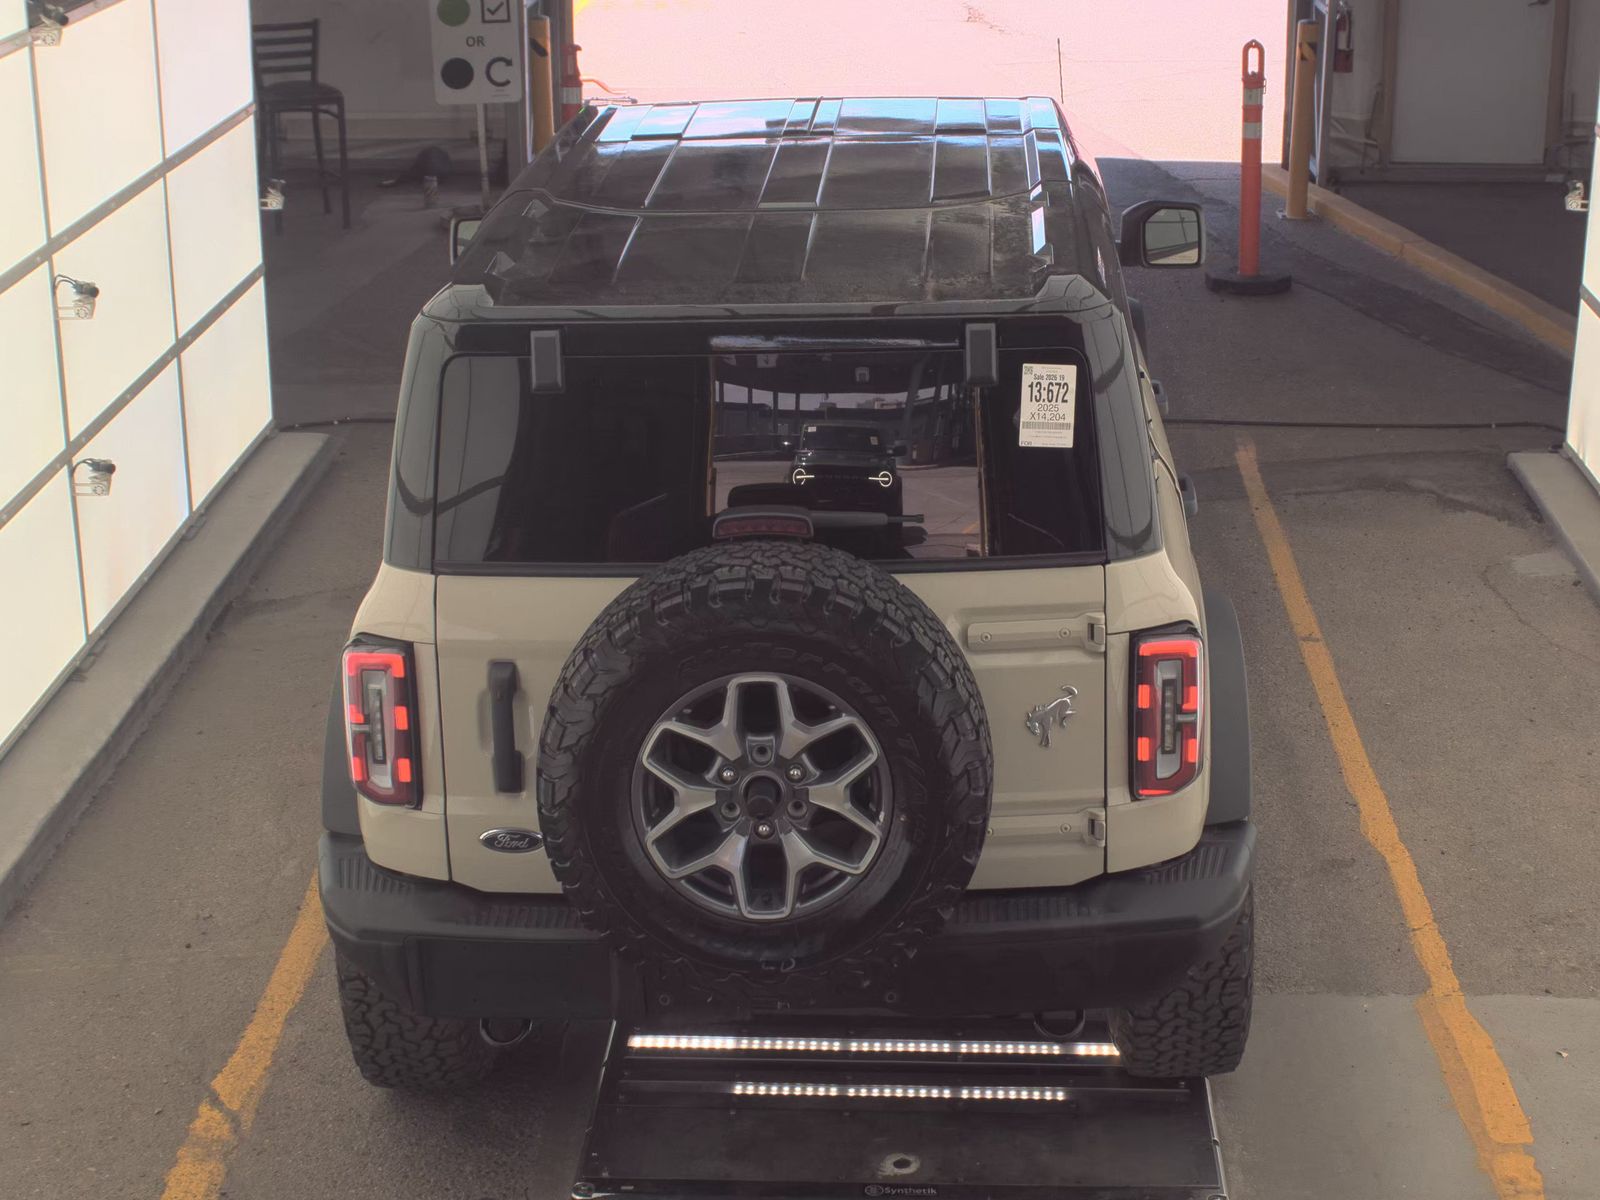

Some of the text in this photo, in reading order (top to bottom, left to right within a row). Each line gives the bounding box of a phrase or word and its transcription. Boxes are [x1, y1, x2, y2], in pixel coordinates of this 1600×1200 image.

[465, 35, 486, 47] OR
[1033, 373, 1045, 381] Sale
[1028, 381, 1069, 403] 13:672
[1037, 403, 1060, 412] 2025
[1029, 412, 1066, 422] X14,204
[494, 833, 530, 848] Ford
[883, 1186, 937, 1195] Synthetik
